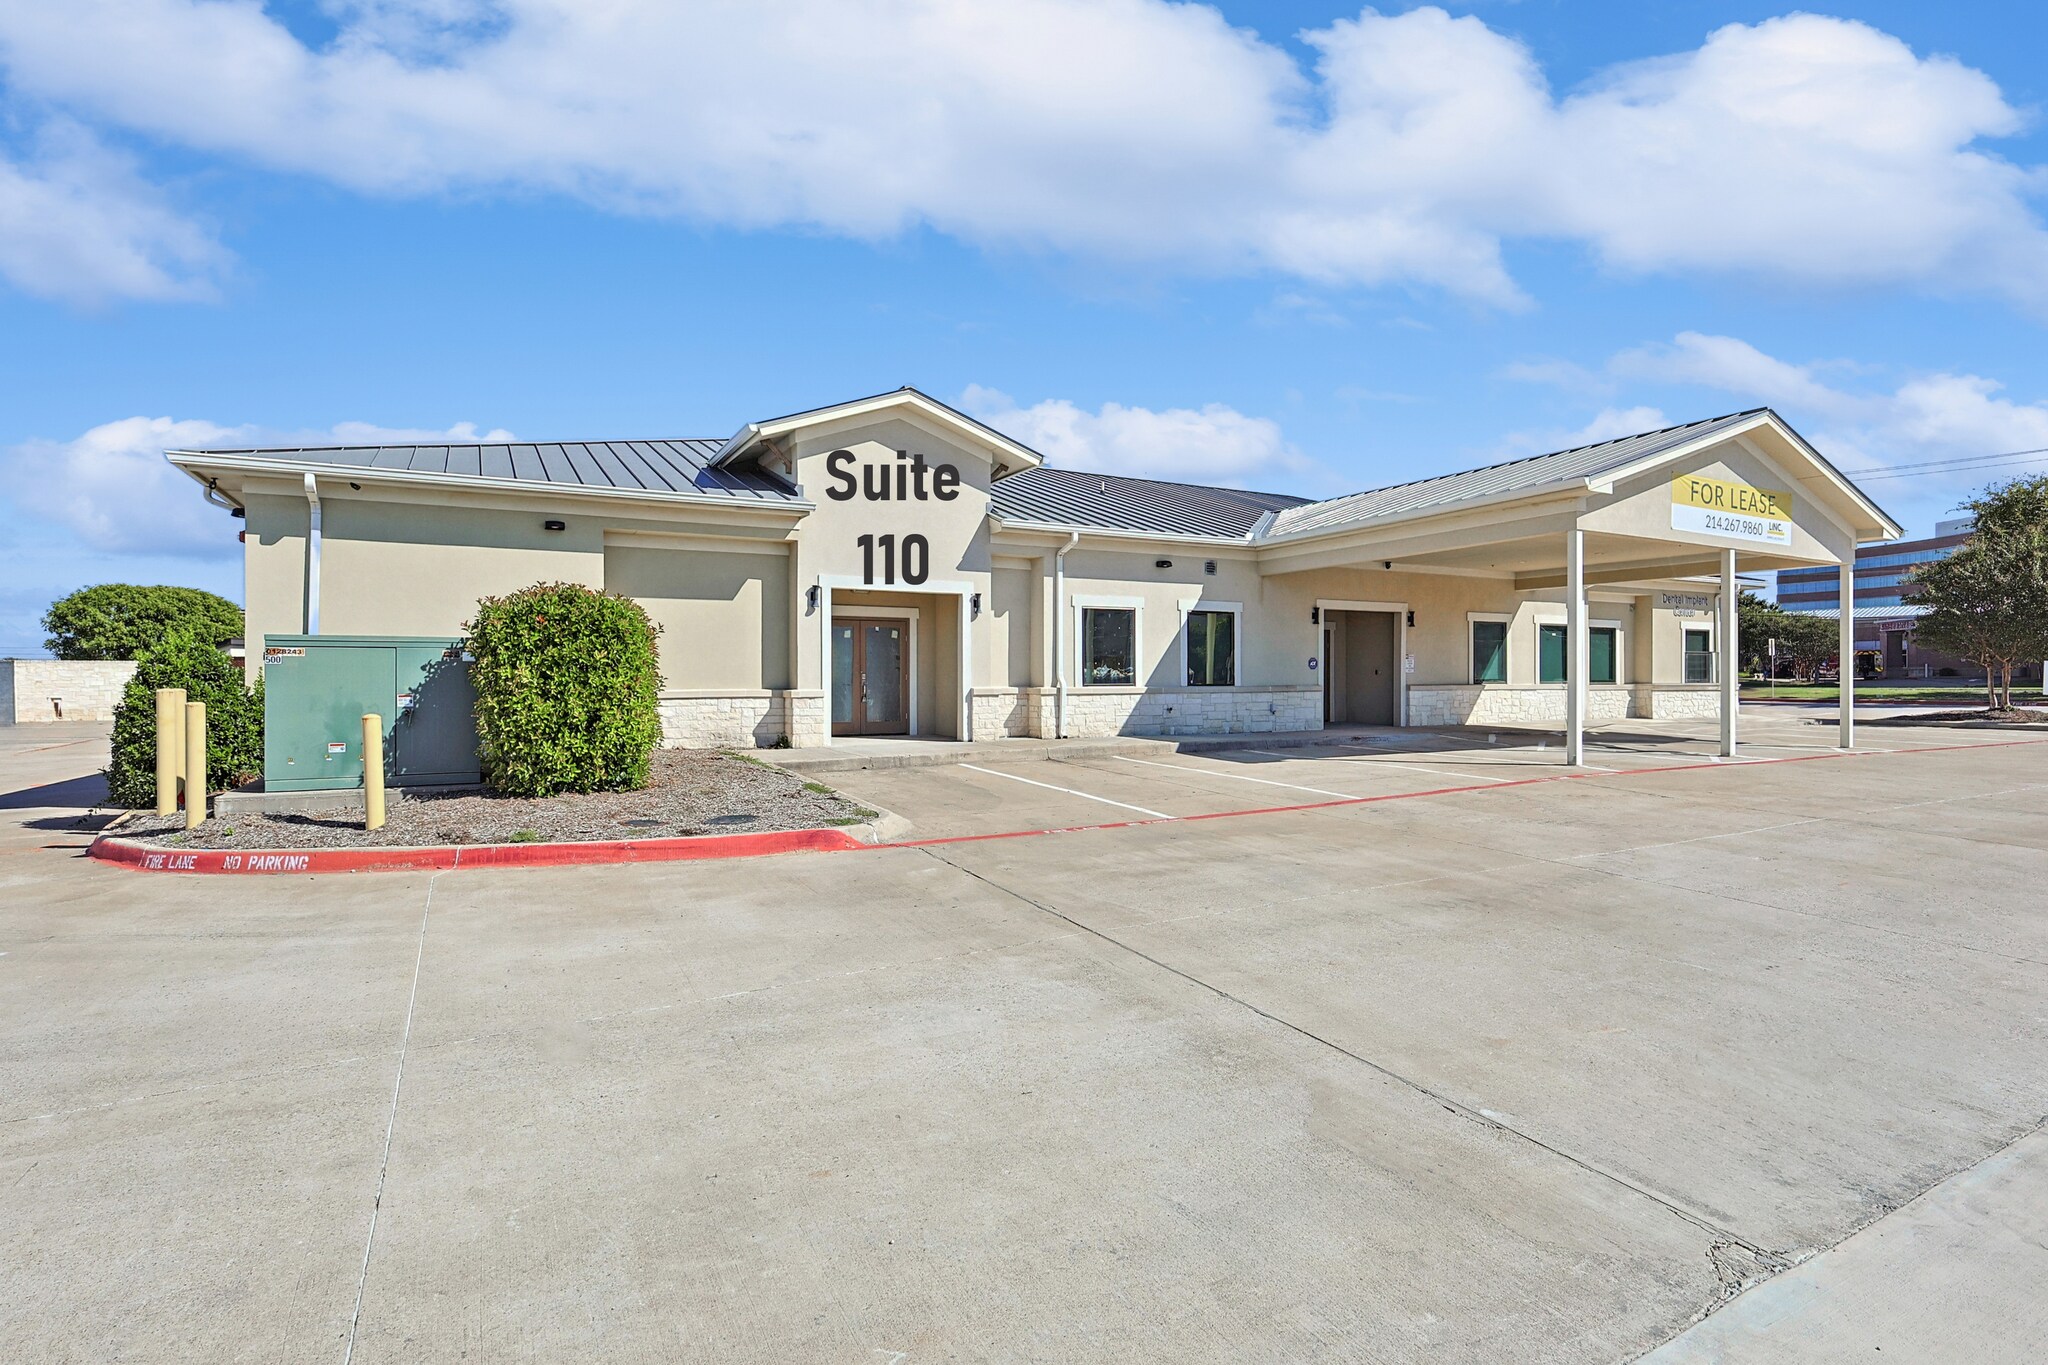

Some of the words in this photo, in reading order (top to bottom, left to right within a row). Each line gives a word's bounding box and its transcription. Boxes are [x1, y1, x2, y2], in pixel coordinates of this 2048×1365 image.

[1690, 480, 1724, 507] FOR
[1730, 488, 1776, 516] LEASE
[1705, 514, 1764, 536] 214.267.9860
[1662, 593, 1684, 605] Dental
[144, 854, 167, 869] FIRE
[167, 855, 198, 870] LANE
[222, 855, 242, 870] NO
[247, 855, 310, 871] PARKING
